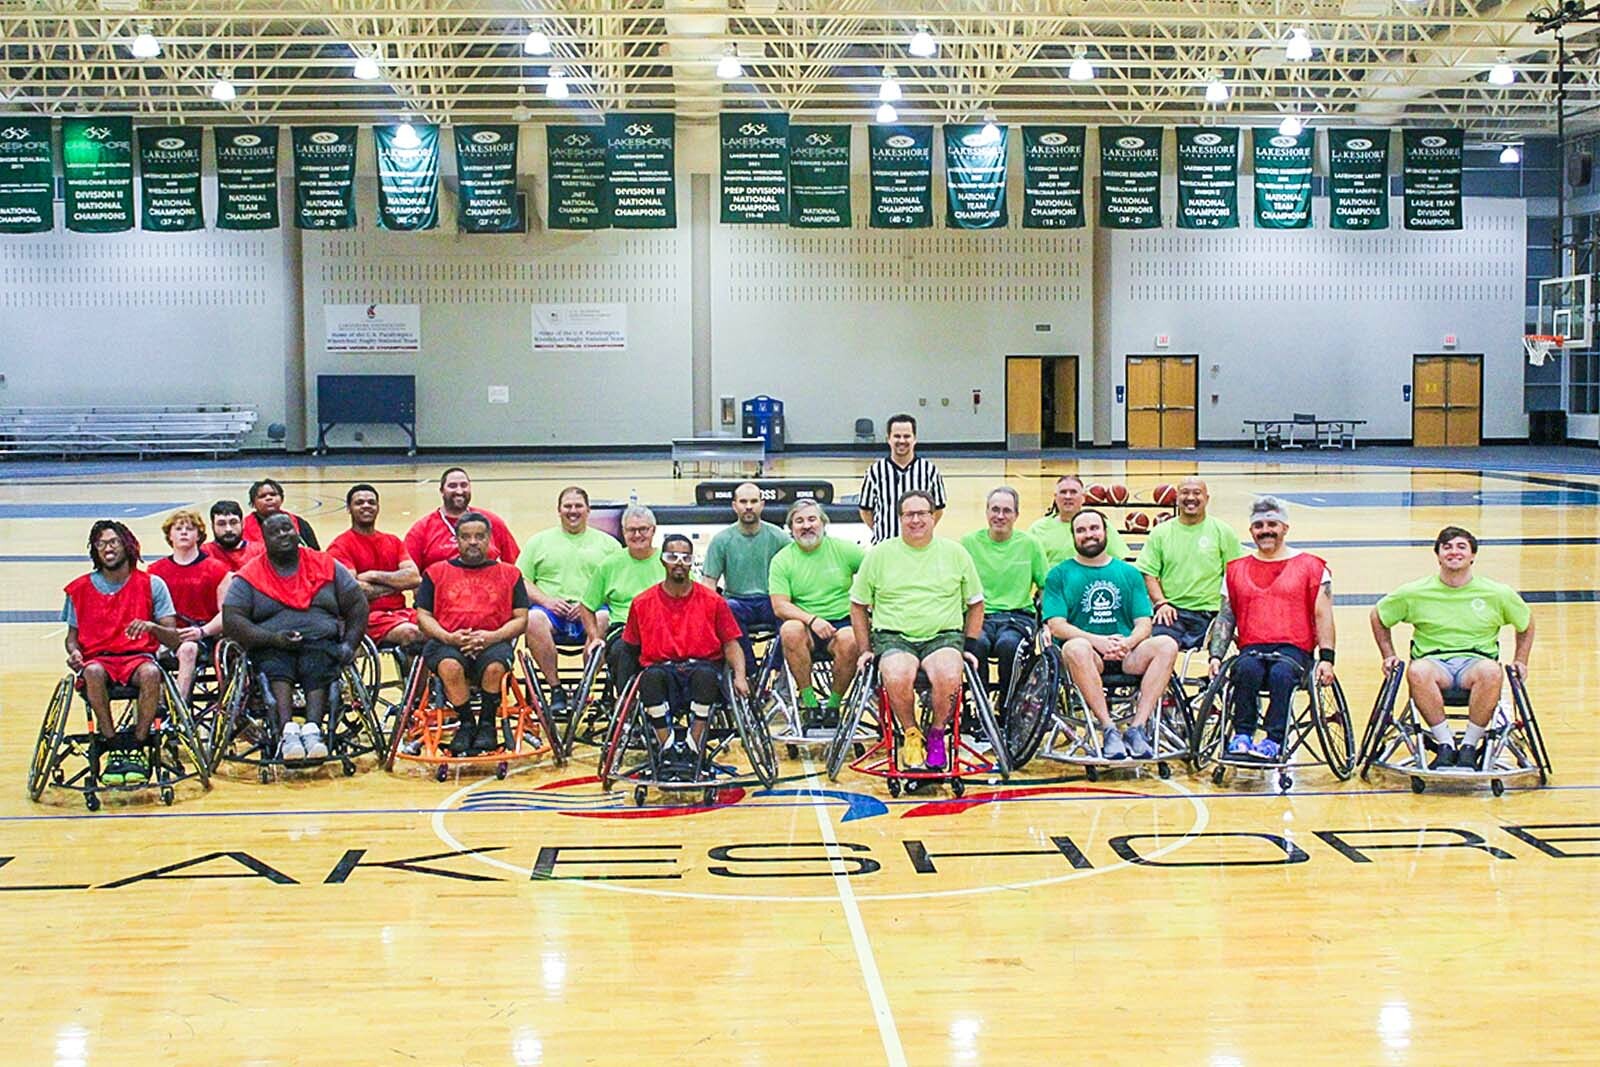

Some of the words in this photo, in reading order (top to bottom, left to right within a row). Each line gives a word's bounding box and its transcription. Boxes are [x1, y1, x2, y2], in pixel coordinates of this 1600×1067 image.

[608, 137, 672, 146] LAKESHORE
[723, 137, 786, 146] LAKESHORE
[218, 147, 276, 156] LAKESHORE
[296, 144, 353, 153] LAKESHORE
[458, 143, 515, 153] LAKESHORE
[872, 147, 929, 156] LAKESHORE
[1027, 146, 1081, 154] LAKESHORE
[1180, 145, 1235, 153] LAKESHORE
[1256, 147, 1311, 156] LAKESHORE
[143, 149, 199, 158] LAKESHORE
[1103, 148, 1158, 157] LAKESHORE
[1331, 150, 1385, 159] LAKESHORE
[958, 192, 996, 200] NATIONAL
[1111, 196, 1149, 204] NATIONAL
[1265, 193, 1303, 201] NATIONAL
[306, 199, 344, 207] NATIONAL
[387, 197, 427, 205] NATIONAL
[469, 199, 508, 207] NATIONAL
[1035, 199, 1072, 207] NATIONAL
[1188, 199, 1225, 207] NATIONAL
[1339, 198, 1377, 206] NATIONAL
[384, 206, 431, 214] CHAMPIONS
[729, 204, 780, 212] CHAMPIONS
[877, 205, 924, 213] CHAMPIONS
[1107, 205, 1153, 213] CHAMPIONS
[1273, 202, 1295, 210] TEAM
[148, 208, 196, 216] CHAMPIONS
[302, 208, 348, 216] CHAMPIONS
[466, 208, 512, 216] CHAMPIONS
[614, 208, 666, 216] CHAMPIONS
[954, 210, 1000, 219] CHAMPIONS
[1030, 208, 1077, 216] CHAMPIONS
[1184, 208, 1230, 216] CHAMPIONS
[1261, 211, 1307, 219] CHAMPIONS
[1336, 207, 1381, 215] CHAMPIONS
[73, 212, 127, 220] CHAMPIONS
[225, 212, 272, 220] CHAMPIONS
